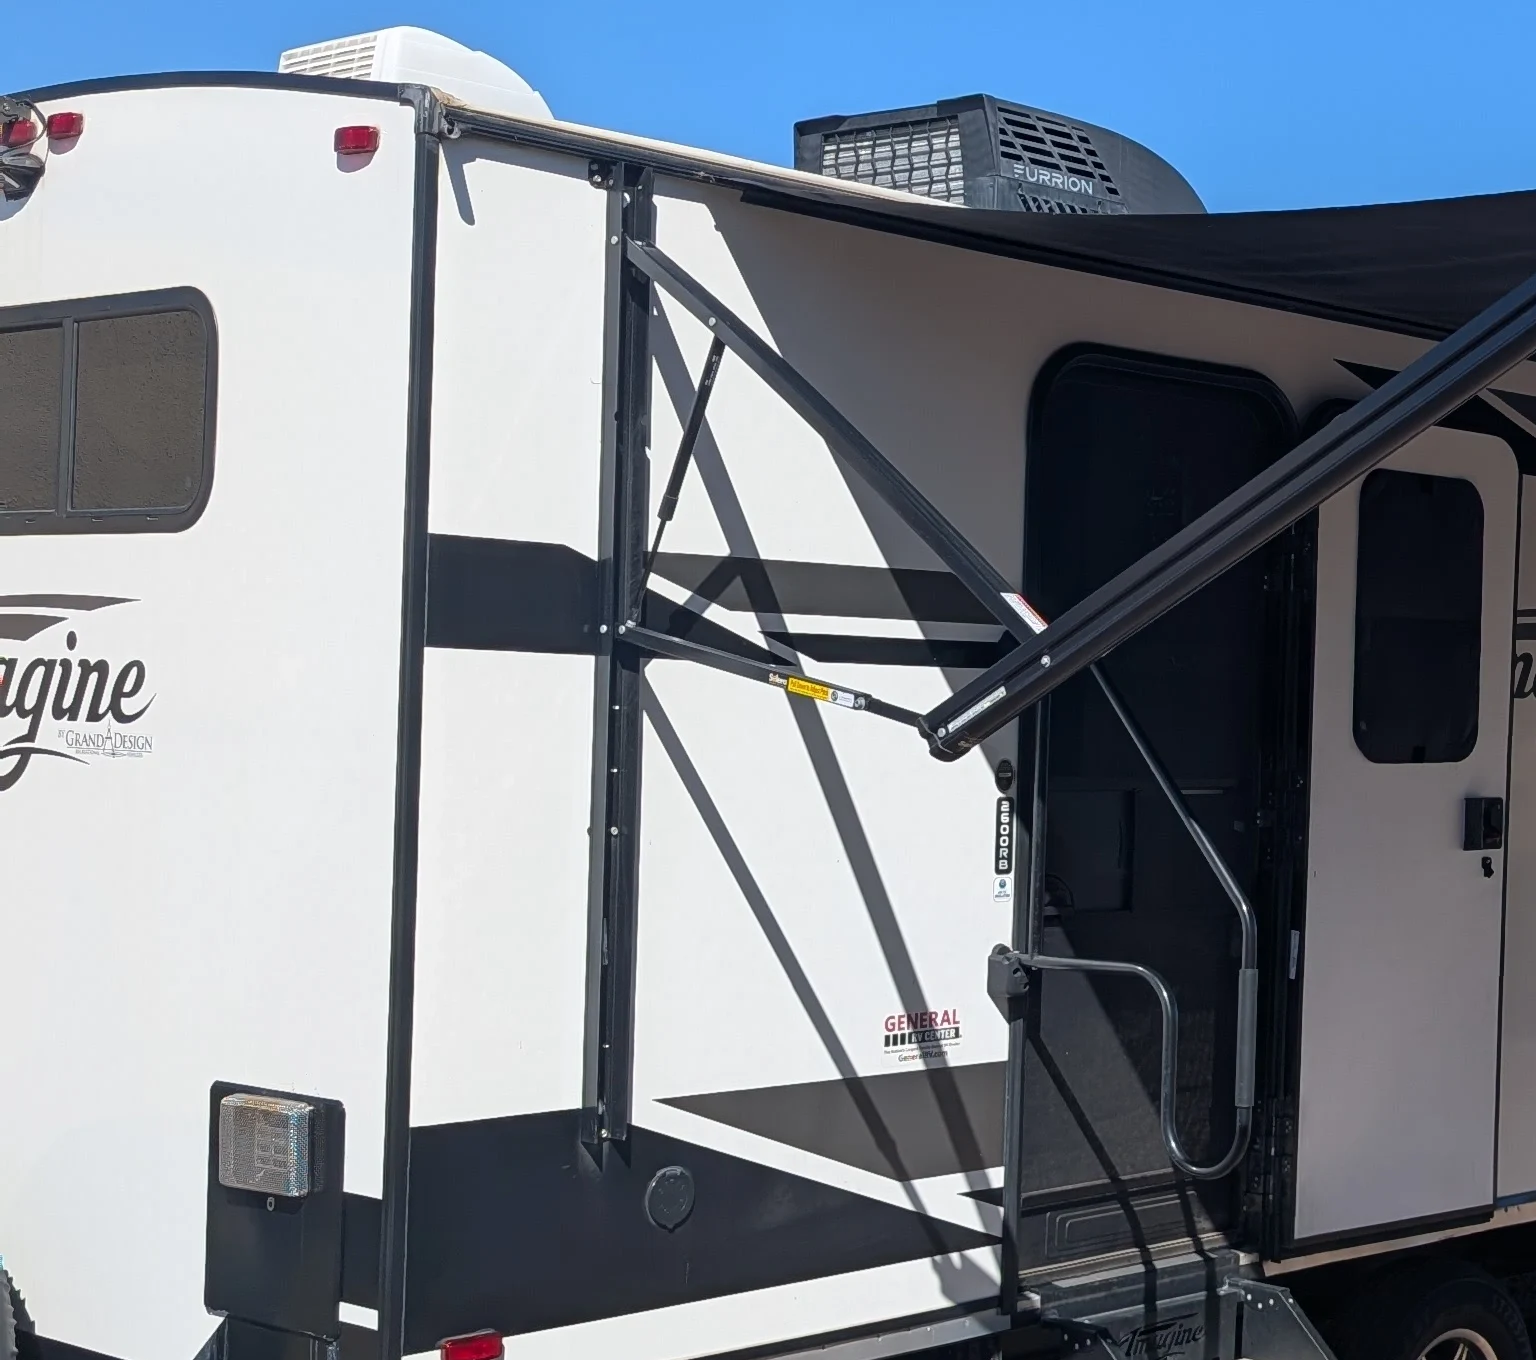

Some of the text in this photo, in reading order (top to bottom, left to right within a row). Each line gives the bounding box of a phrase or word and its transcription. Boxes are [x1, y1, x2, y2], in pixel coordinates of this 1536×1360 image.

[1013, 163, 1093, 195] FURRION
[65, 730, 105, 747] GRAND
[114, 732, 153, 751] DESIGN
[998, 800, 1011, 870] 2600RB
[884, 1009, 960, 1032] GENERAL
[911, 1028, 956, 1043] RV CENTER
